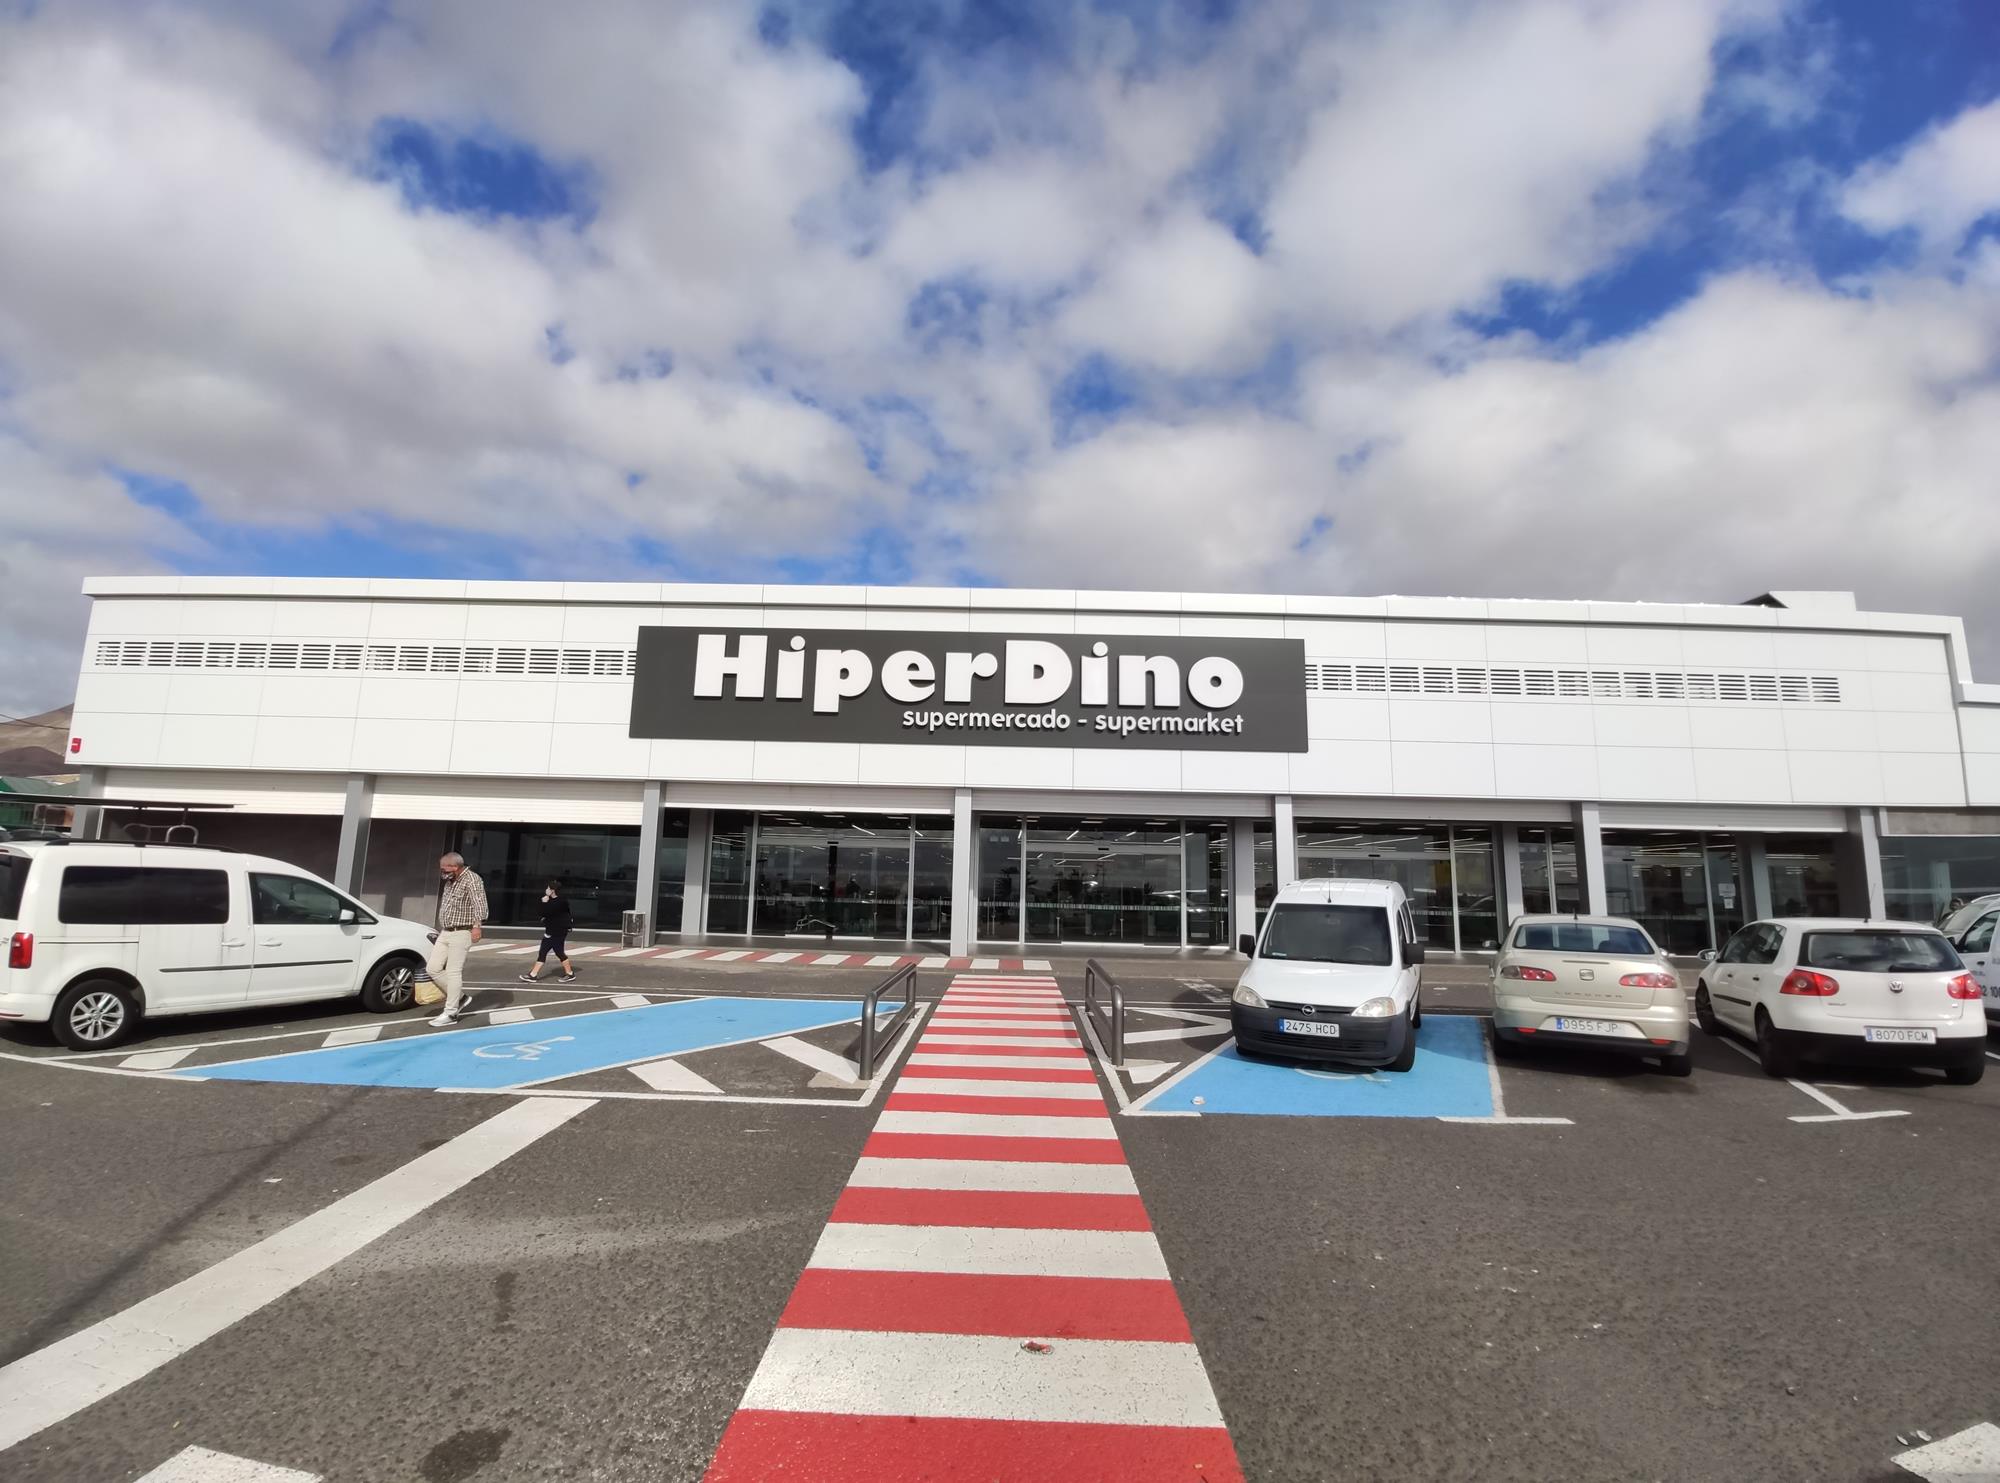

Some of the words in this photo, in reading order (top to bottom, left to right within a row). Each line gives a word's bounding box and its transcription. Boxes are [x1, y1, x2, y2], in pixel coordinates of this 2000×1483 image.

[694, 633, 1244, 713] HiperDino
[902, 708, 1071, 732] supermercado
[1095, 711, 1244, 736] supermarket
[1285, 1021, 1312, 1033] 2475
[1315, 1023, 1337, 1035] HCD
[1563, 1019, 1594, 1032] 0955
[1875, 1029, 1905, 1041] 8070
[1907, 1030, 1929, 1041] FCM
